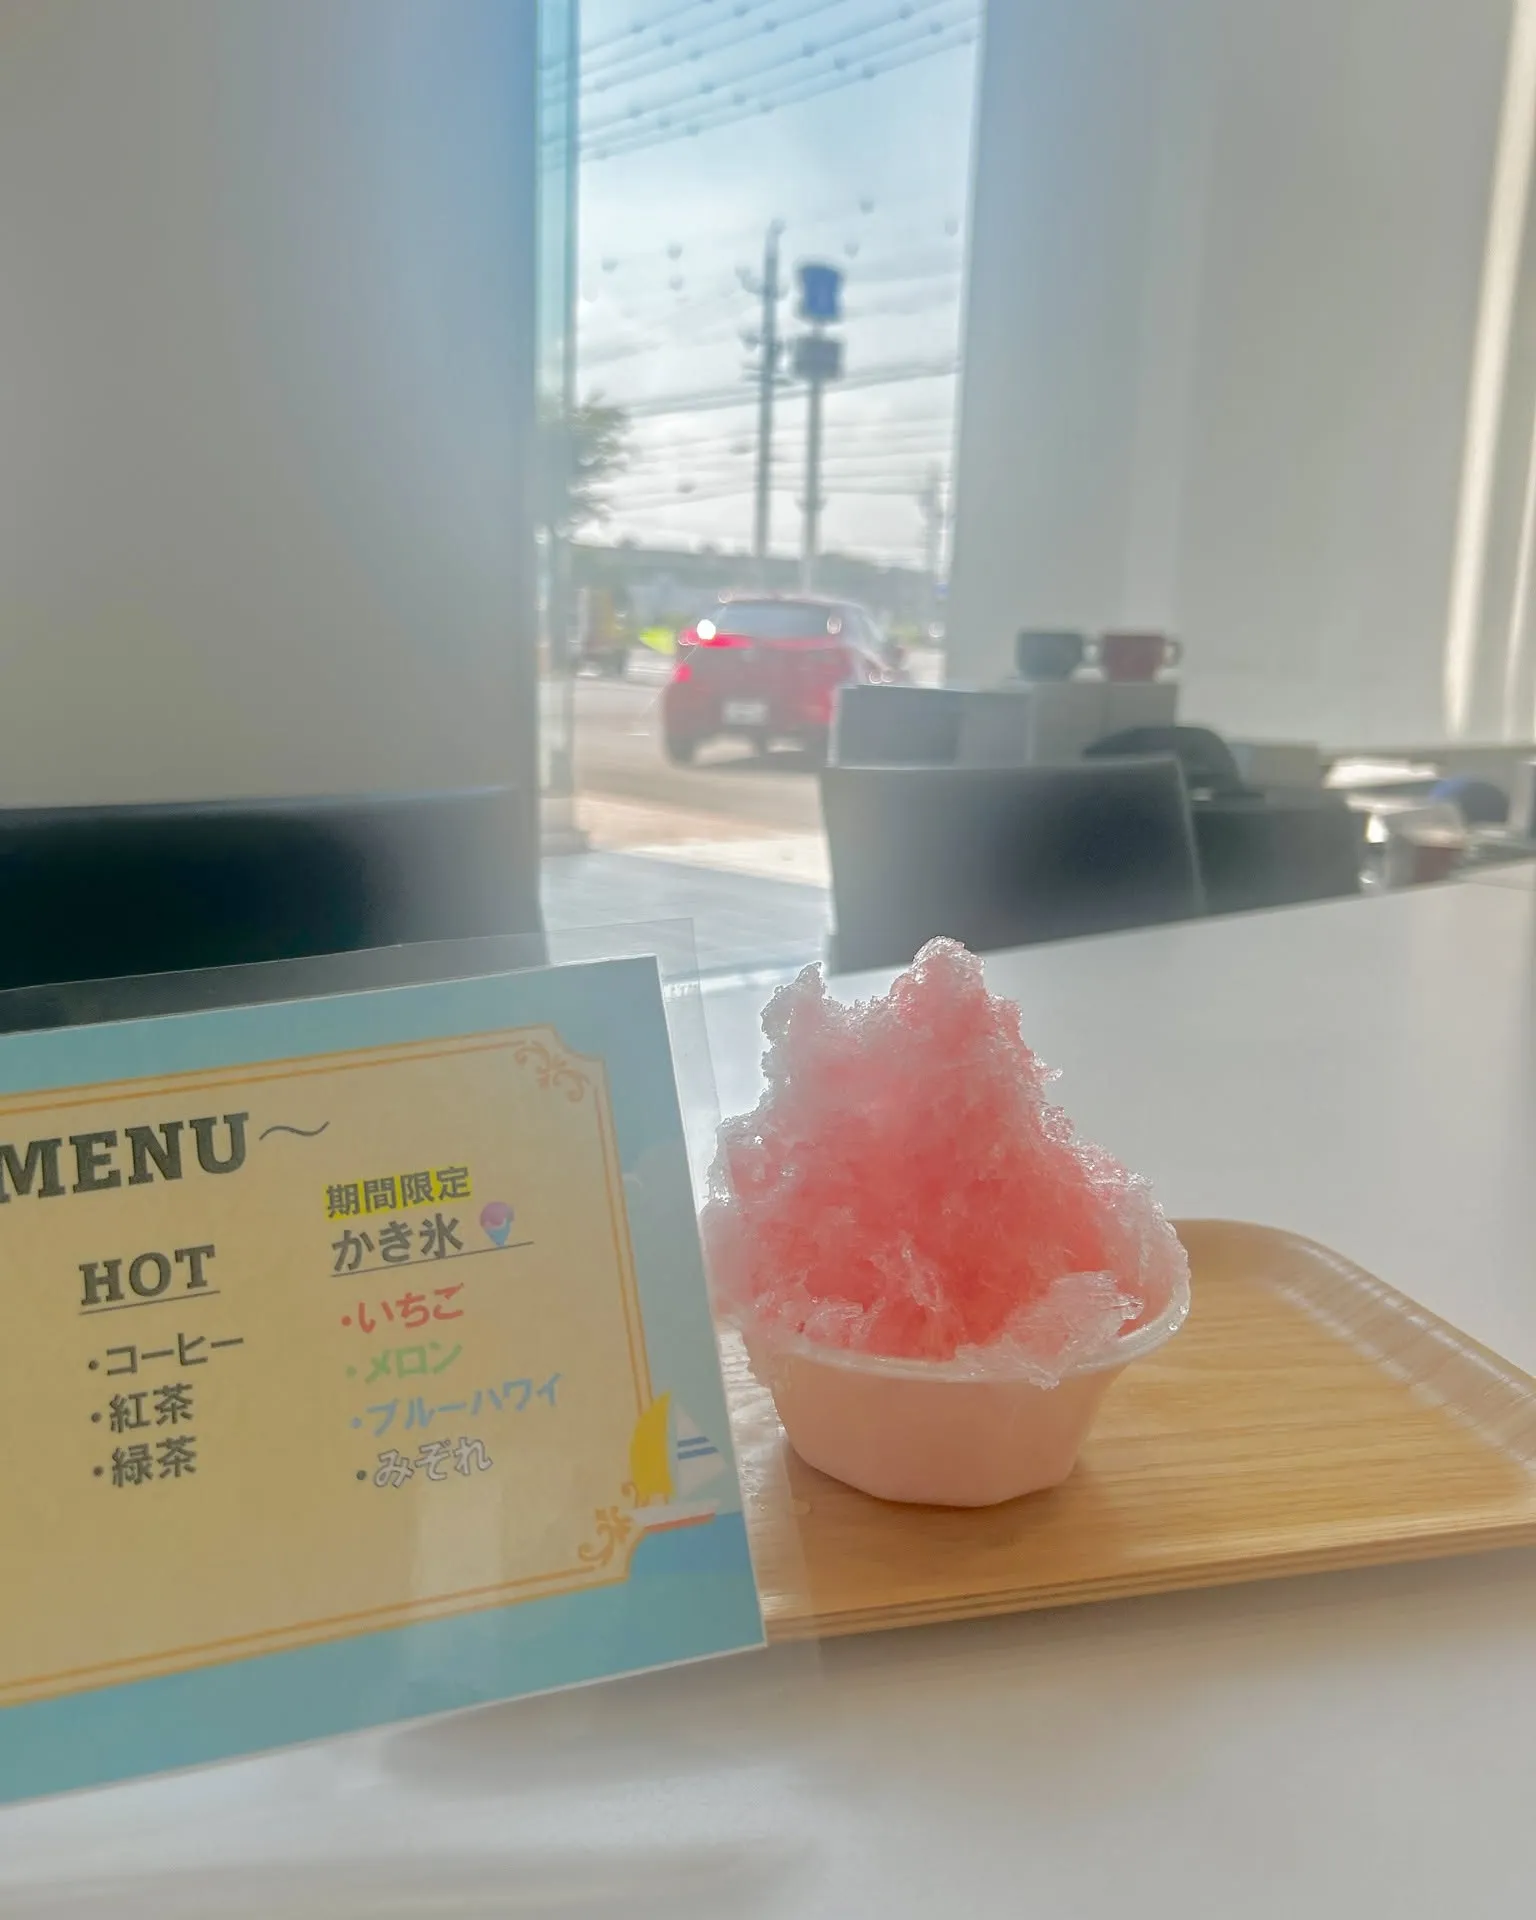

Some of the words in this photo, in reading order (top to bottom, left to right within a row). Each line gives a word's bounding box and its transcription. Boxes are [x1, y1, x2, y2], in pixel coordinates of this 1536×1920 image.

[326, 1166, 471, 1218] 期間限定
[332, 1212, 464, 1272] かき氷
[79, 1244, 216, 1305] HOT
